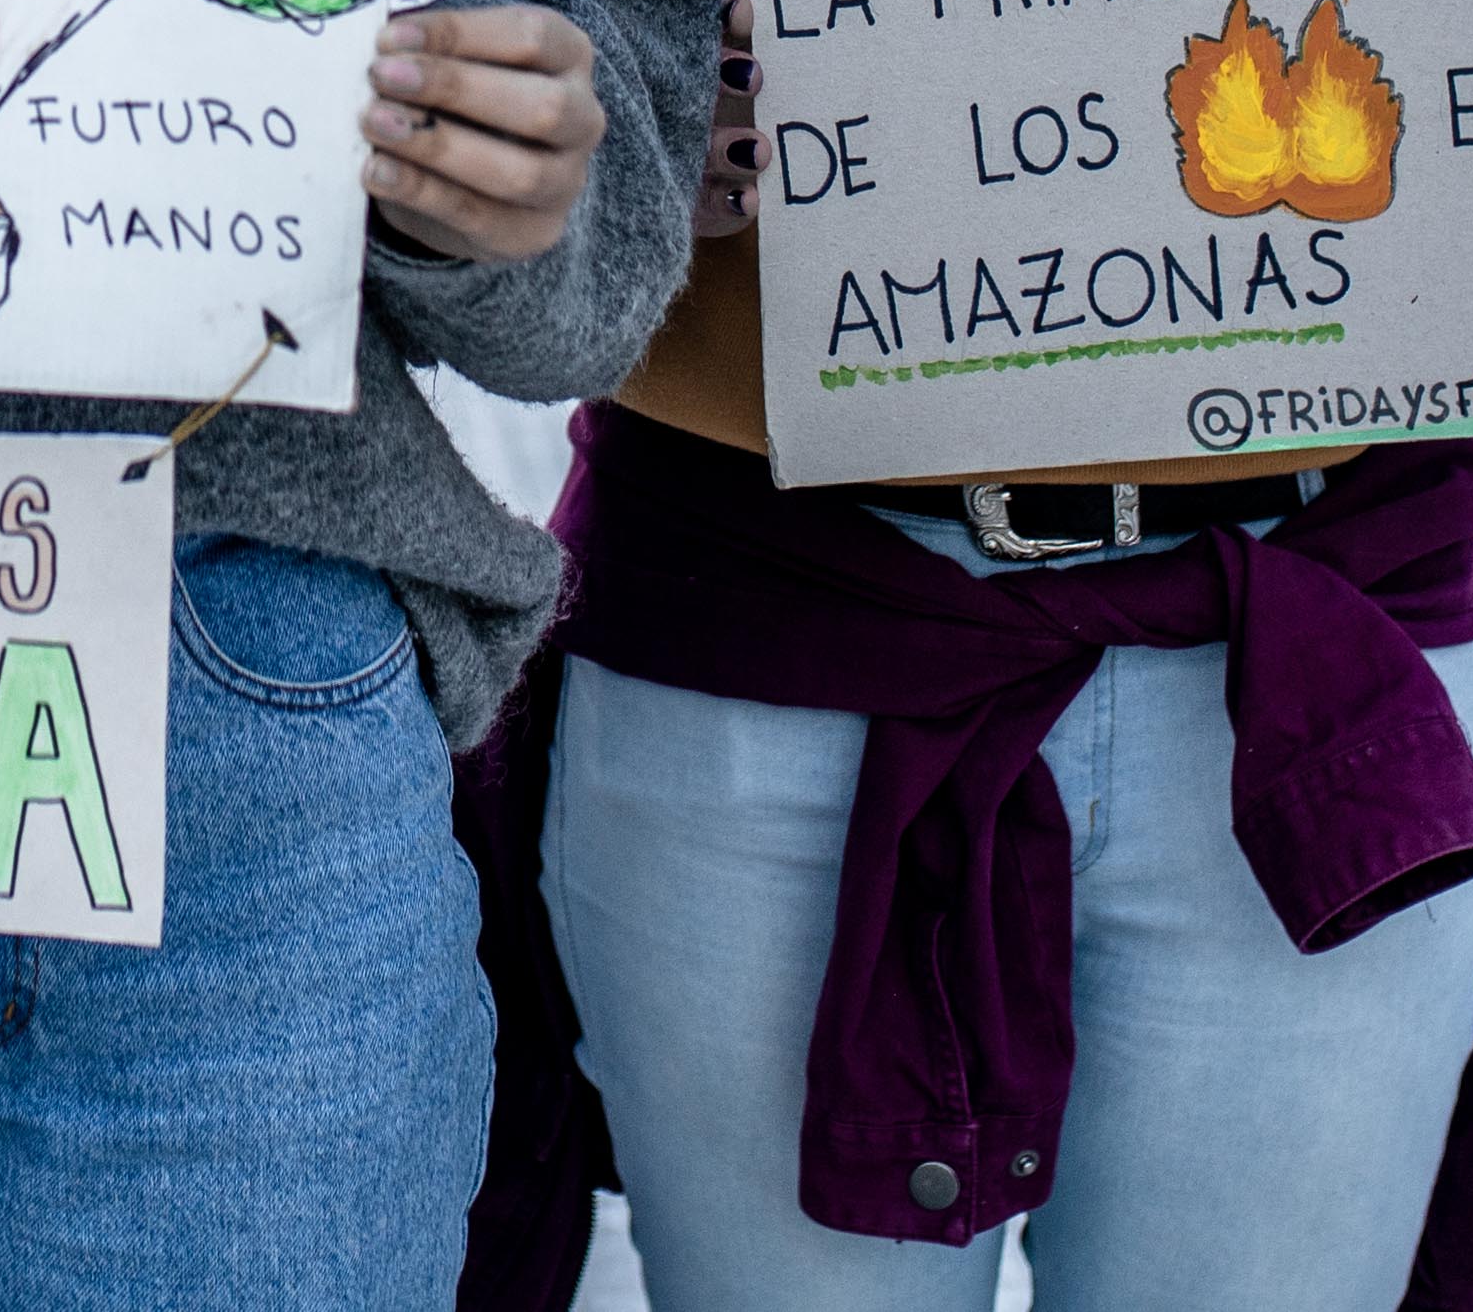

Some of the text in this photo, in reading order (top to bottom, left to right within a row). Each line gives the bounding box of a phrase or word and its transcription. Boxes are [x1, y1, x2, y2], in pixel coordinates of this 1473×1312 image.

[29, 98, 296, 148] FUTURO
[775, 114, 877, 206] DE
[969, 92, 1120, 186] LOS
[63, 201, 302, 260] MANOS
[827, 228, 1351, 358] AMAZONAS
